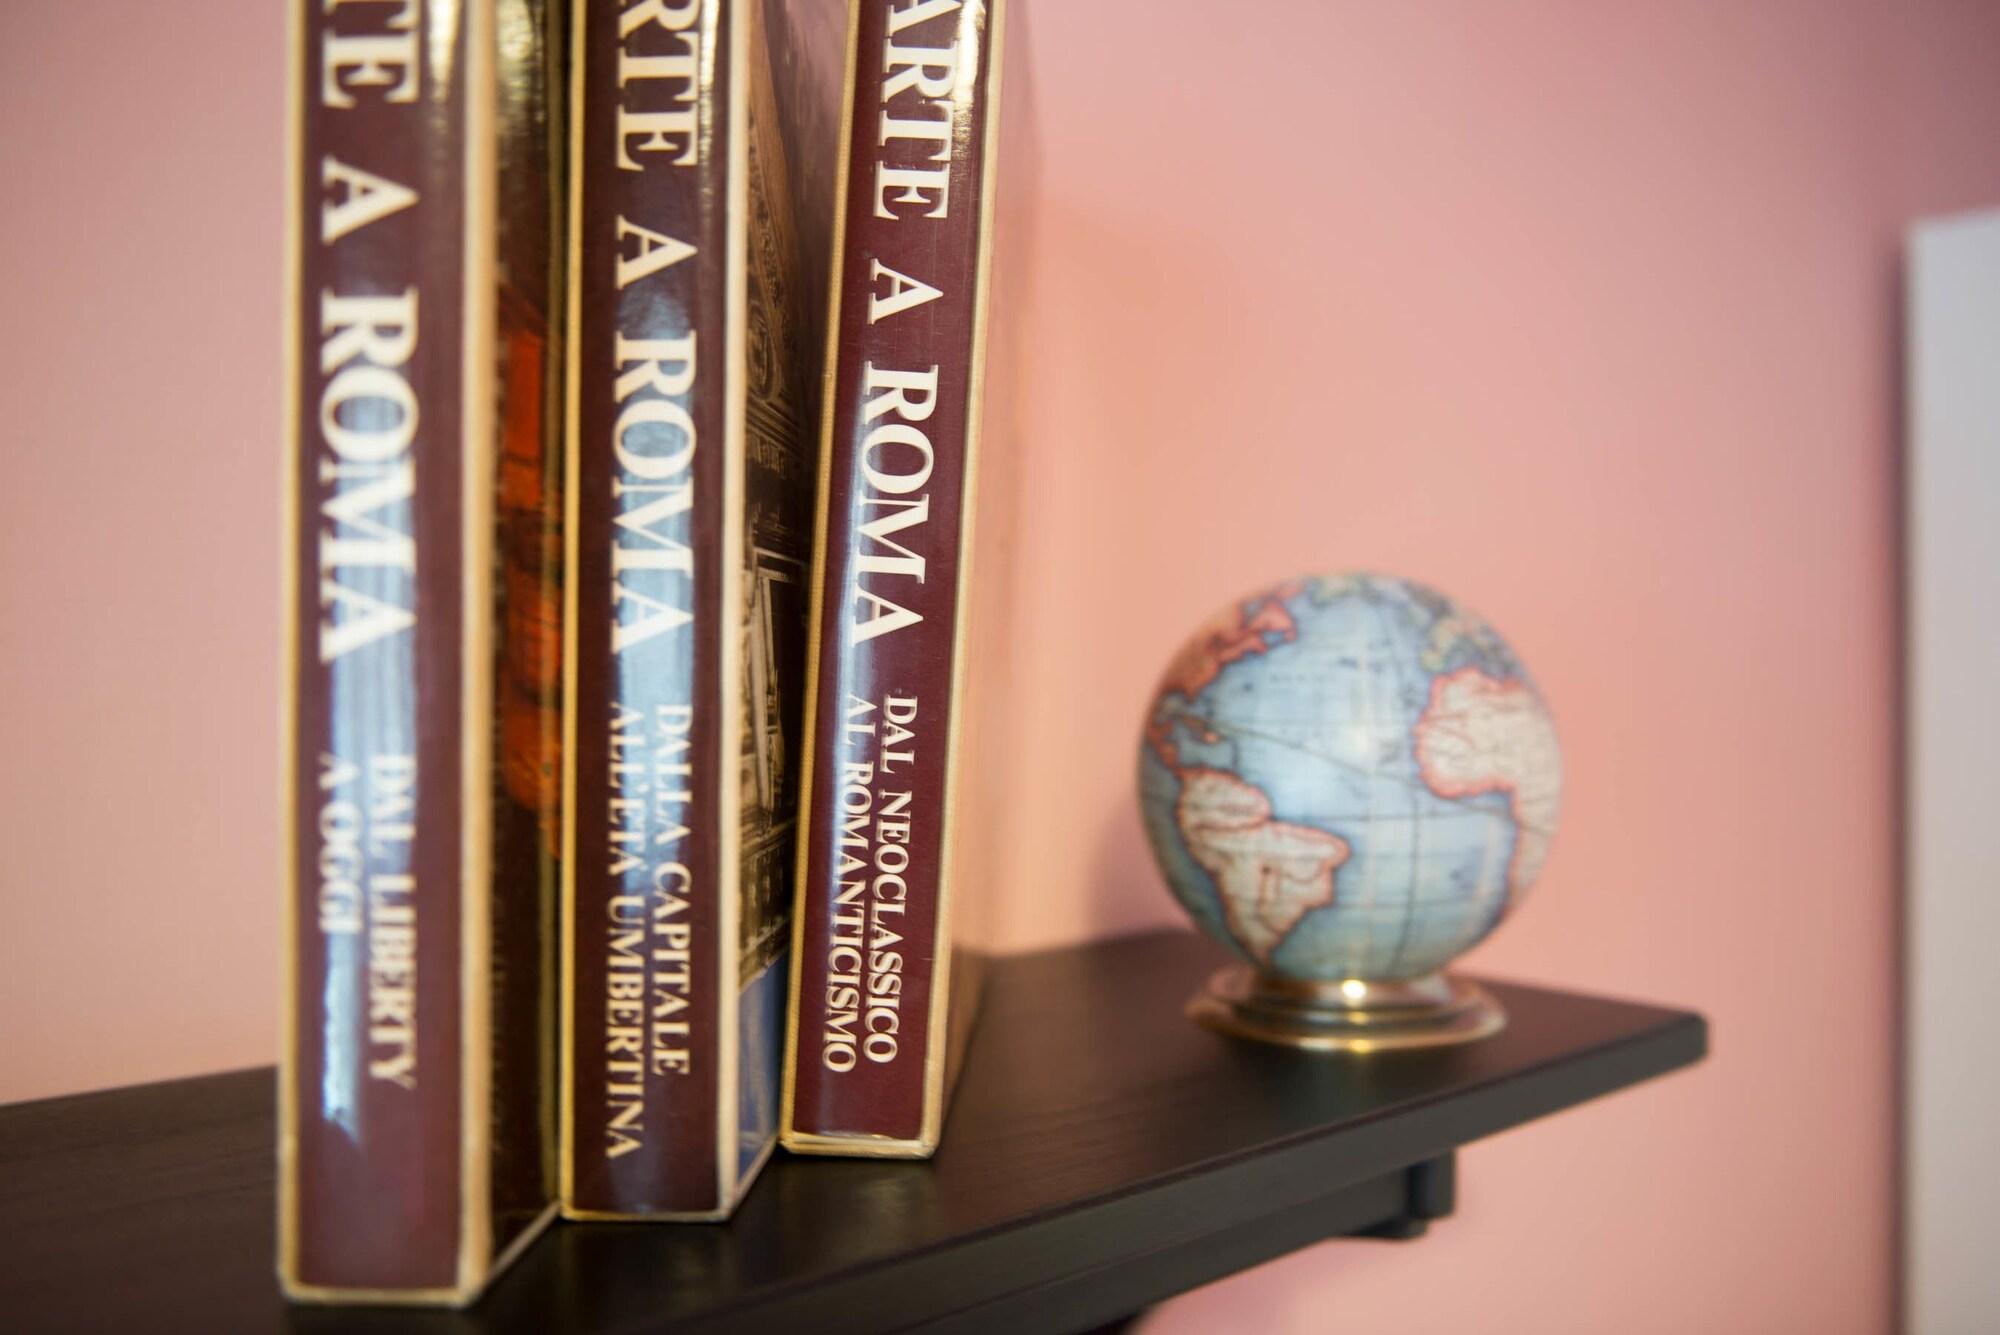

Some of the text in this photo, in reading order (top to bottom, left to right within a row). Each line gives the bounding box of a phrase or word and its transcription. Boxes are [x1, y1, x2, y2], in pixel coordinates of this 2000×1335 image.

[321, 156, 419, 243] A
[614, 214, 698, 291] A
[847, 0, 962, 649] ARTE A ROMA
[318, 287, 419, 663] ROMA
[610, 330, 697, 655] ROMA
[319, 752, 364, 935] A OGGI
[368, 752, 418, 1090] DAL LIBERTY
[651, 702, 692, 1076] DALLA CAPITALE
[821, 693, 878, 1073] AL ROMANTICISMO
[862, 694, 918, 1063] DAL NEOCLASSICO
[606, 894, 646, 1159] UMBERTINA
